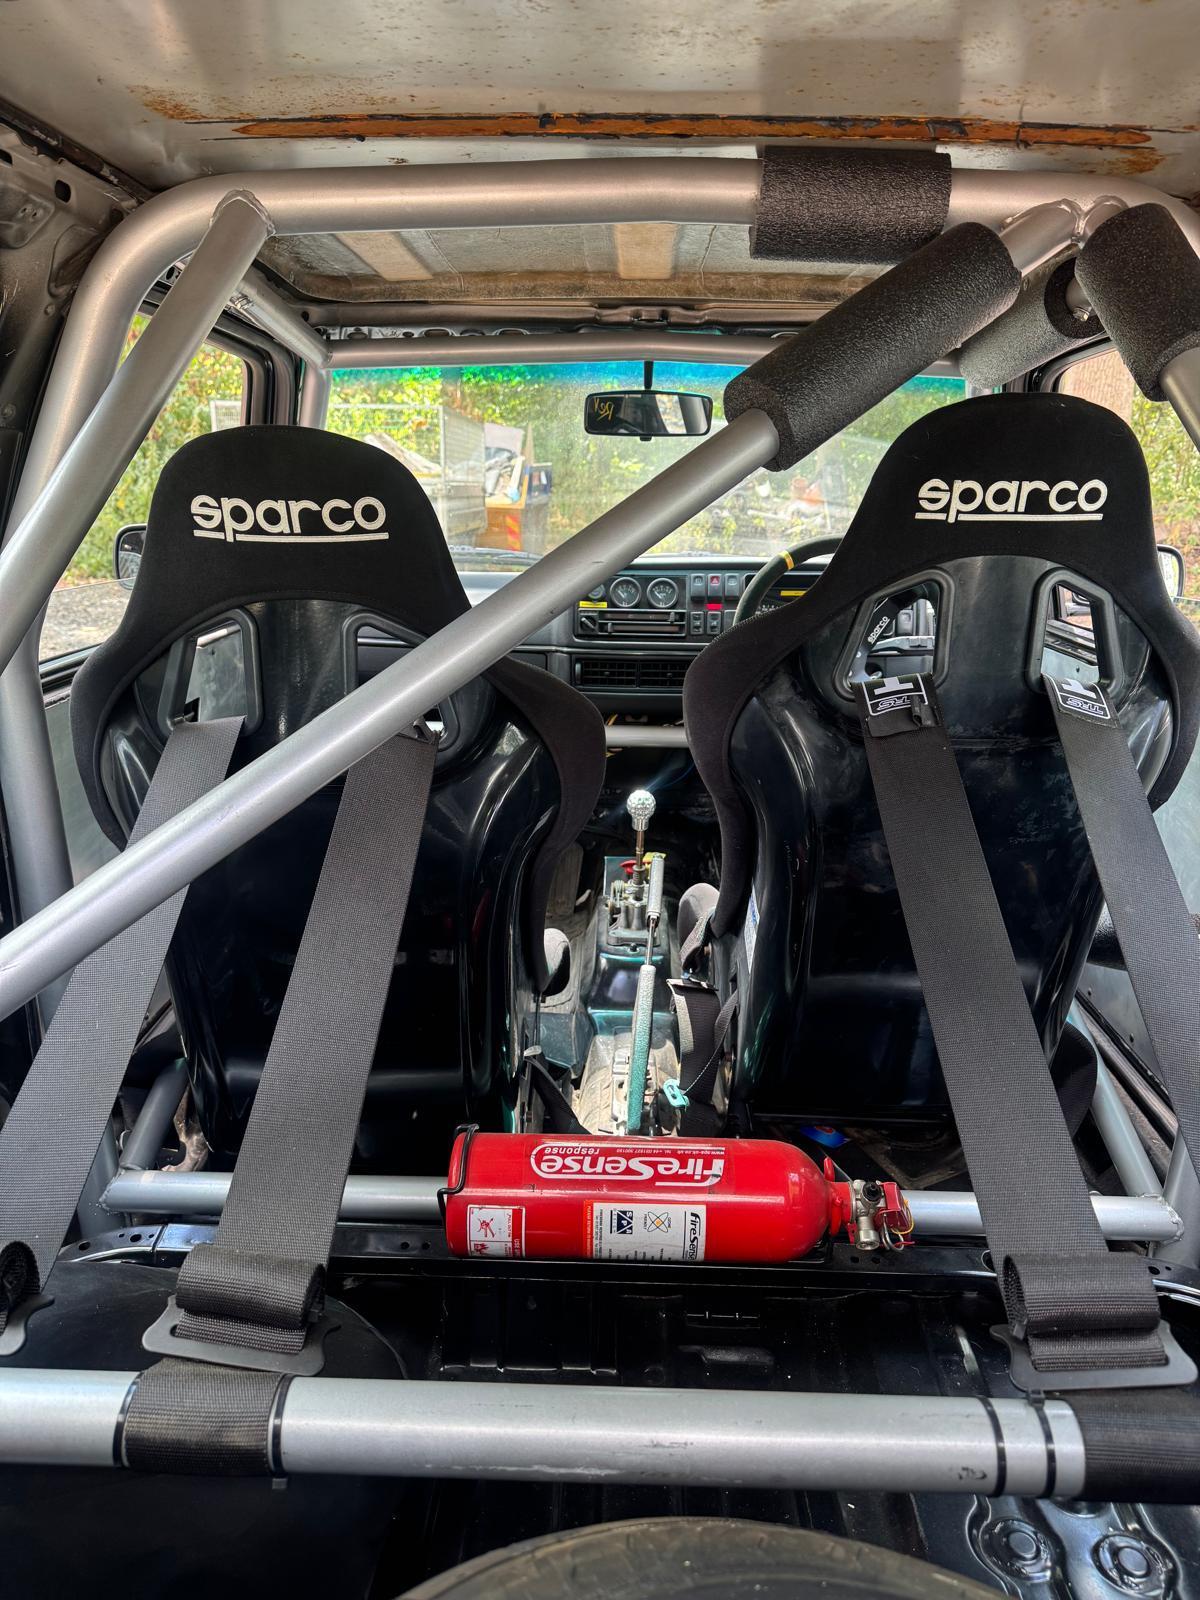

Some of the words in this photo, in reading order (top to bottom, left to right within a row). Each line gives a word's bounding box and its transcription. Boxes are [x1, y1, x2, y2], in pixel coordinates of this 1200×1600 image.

[917, 478, 1109, 524] sparco
[190, 494, 388, 543] sparco
[867, 616, 891, 645] sparco
[1065, 697, 1105, 716] TRS
[544, 1146, 600, 1155] response
